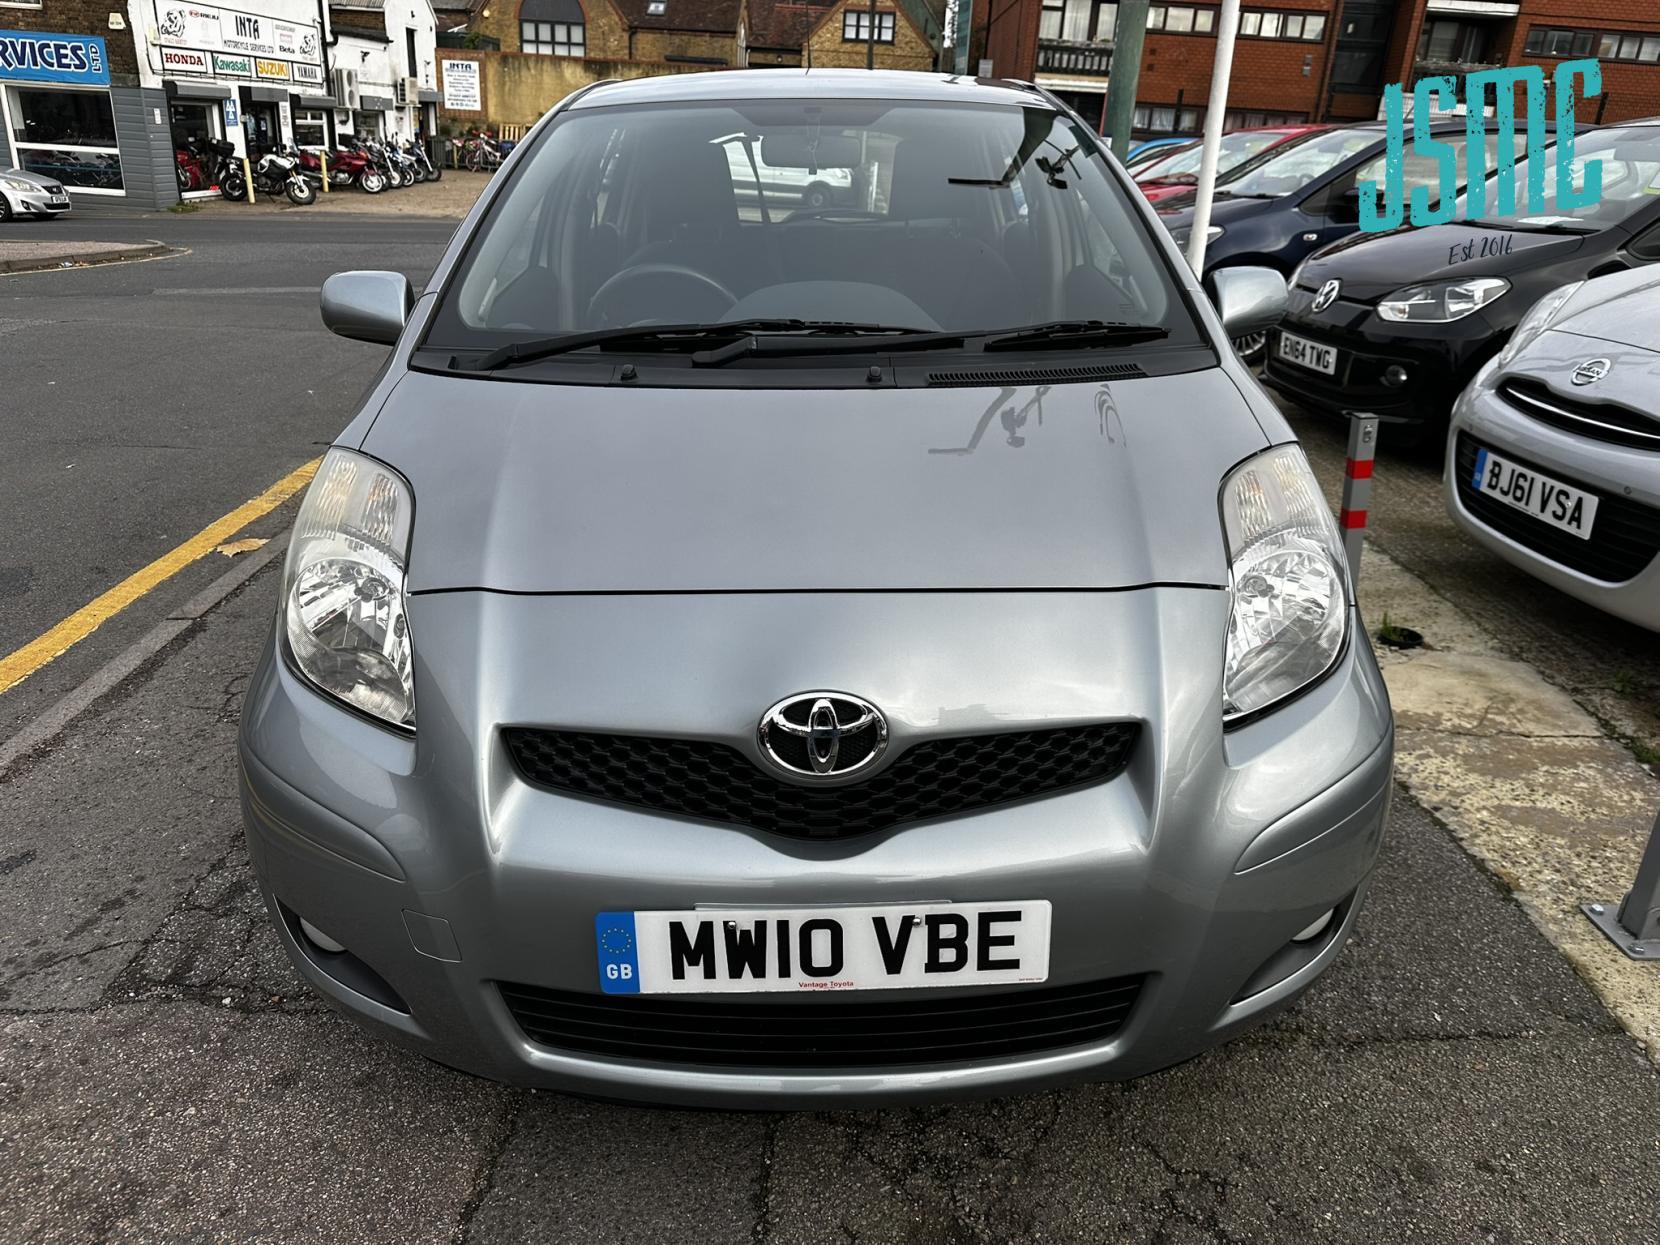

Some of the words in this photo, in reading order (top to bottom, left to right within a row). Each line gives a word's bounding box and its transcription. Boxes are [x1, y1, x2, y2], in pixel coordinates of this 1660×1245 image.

[235, 15, 260, 40] INTA
[90, 44, 101, 72] LTD
[279, 45, 296, 54] Beta
[164, 53, 204, 66] HONDA
[213, 54, 250, 73] Kawasaki
[257, 61, 289, 76] SUZUKI
[297, 66, 318, 79] YAMAHA
[1283, 336, 1307, 361] EN64
[1309, 345, 1332, 369] TWG
[1487, 460, 1535, 506] BJ61
[1541, 481, 1584, 530] VSA
[669, 918, 844, 980] MW10
[872, 910, 1022, 976] VBE
[606, 963, 633, 979] GB
[798, 981, 828, 989] Vantage
[830, 980, 854, 988] Toyota
